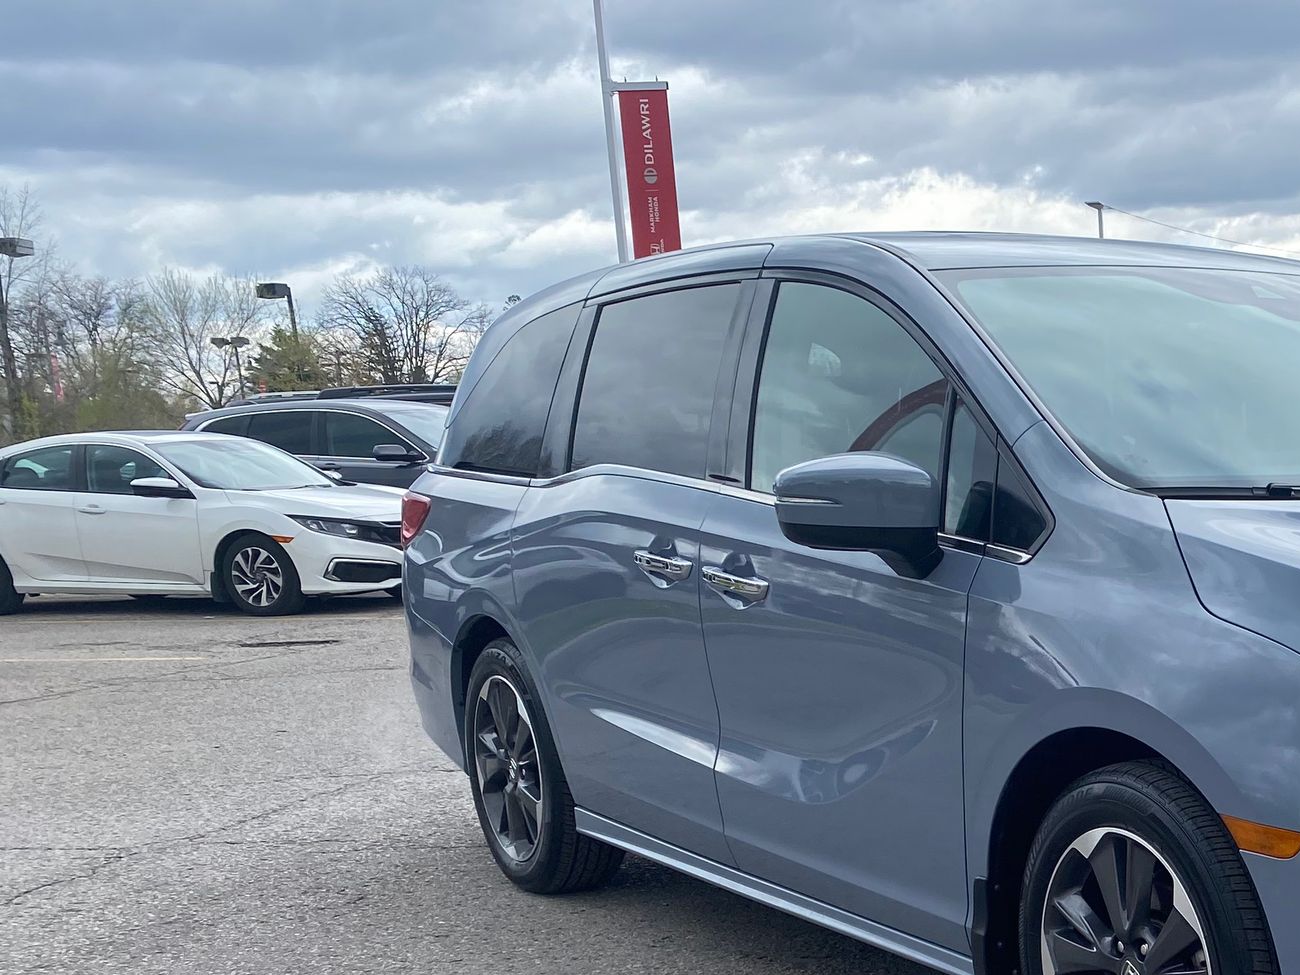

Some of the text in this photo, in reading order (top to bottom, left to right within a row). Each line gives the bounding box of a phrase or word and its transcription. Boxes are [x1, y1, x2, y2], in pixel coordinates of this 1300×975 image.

[640, 99, 654, 164] DILAWRI
[647, 196, 655, 233] MARKHAM
[653, 196, 661, 222] HONDA
